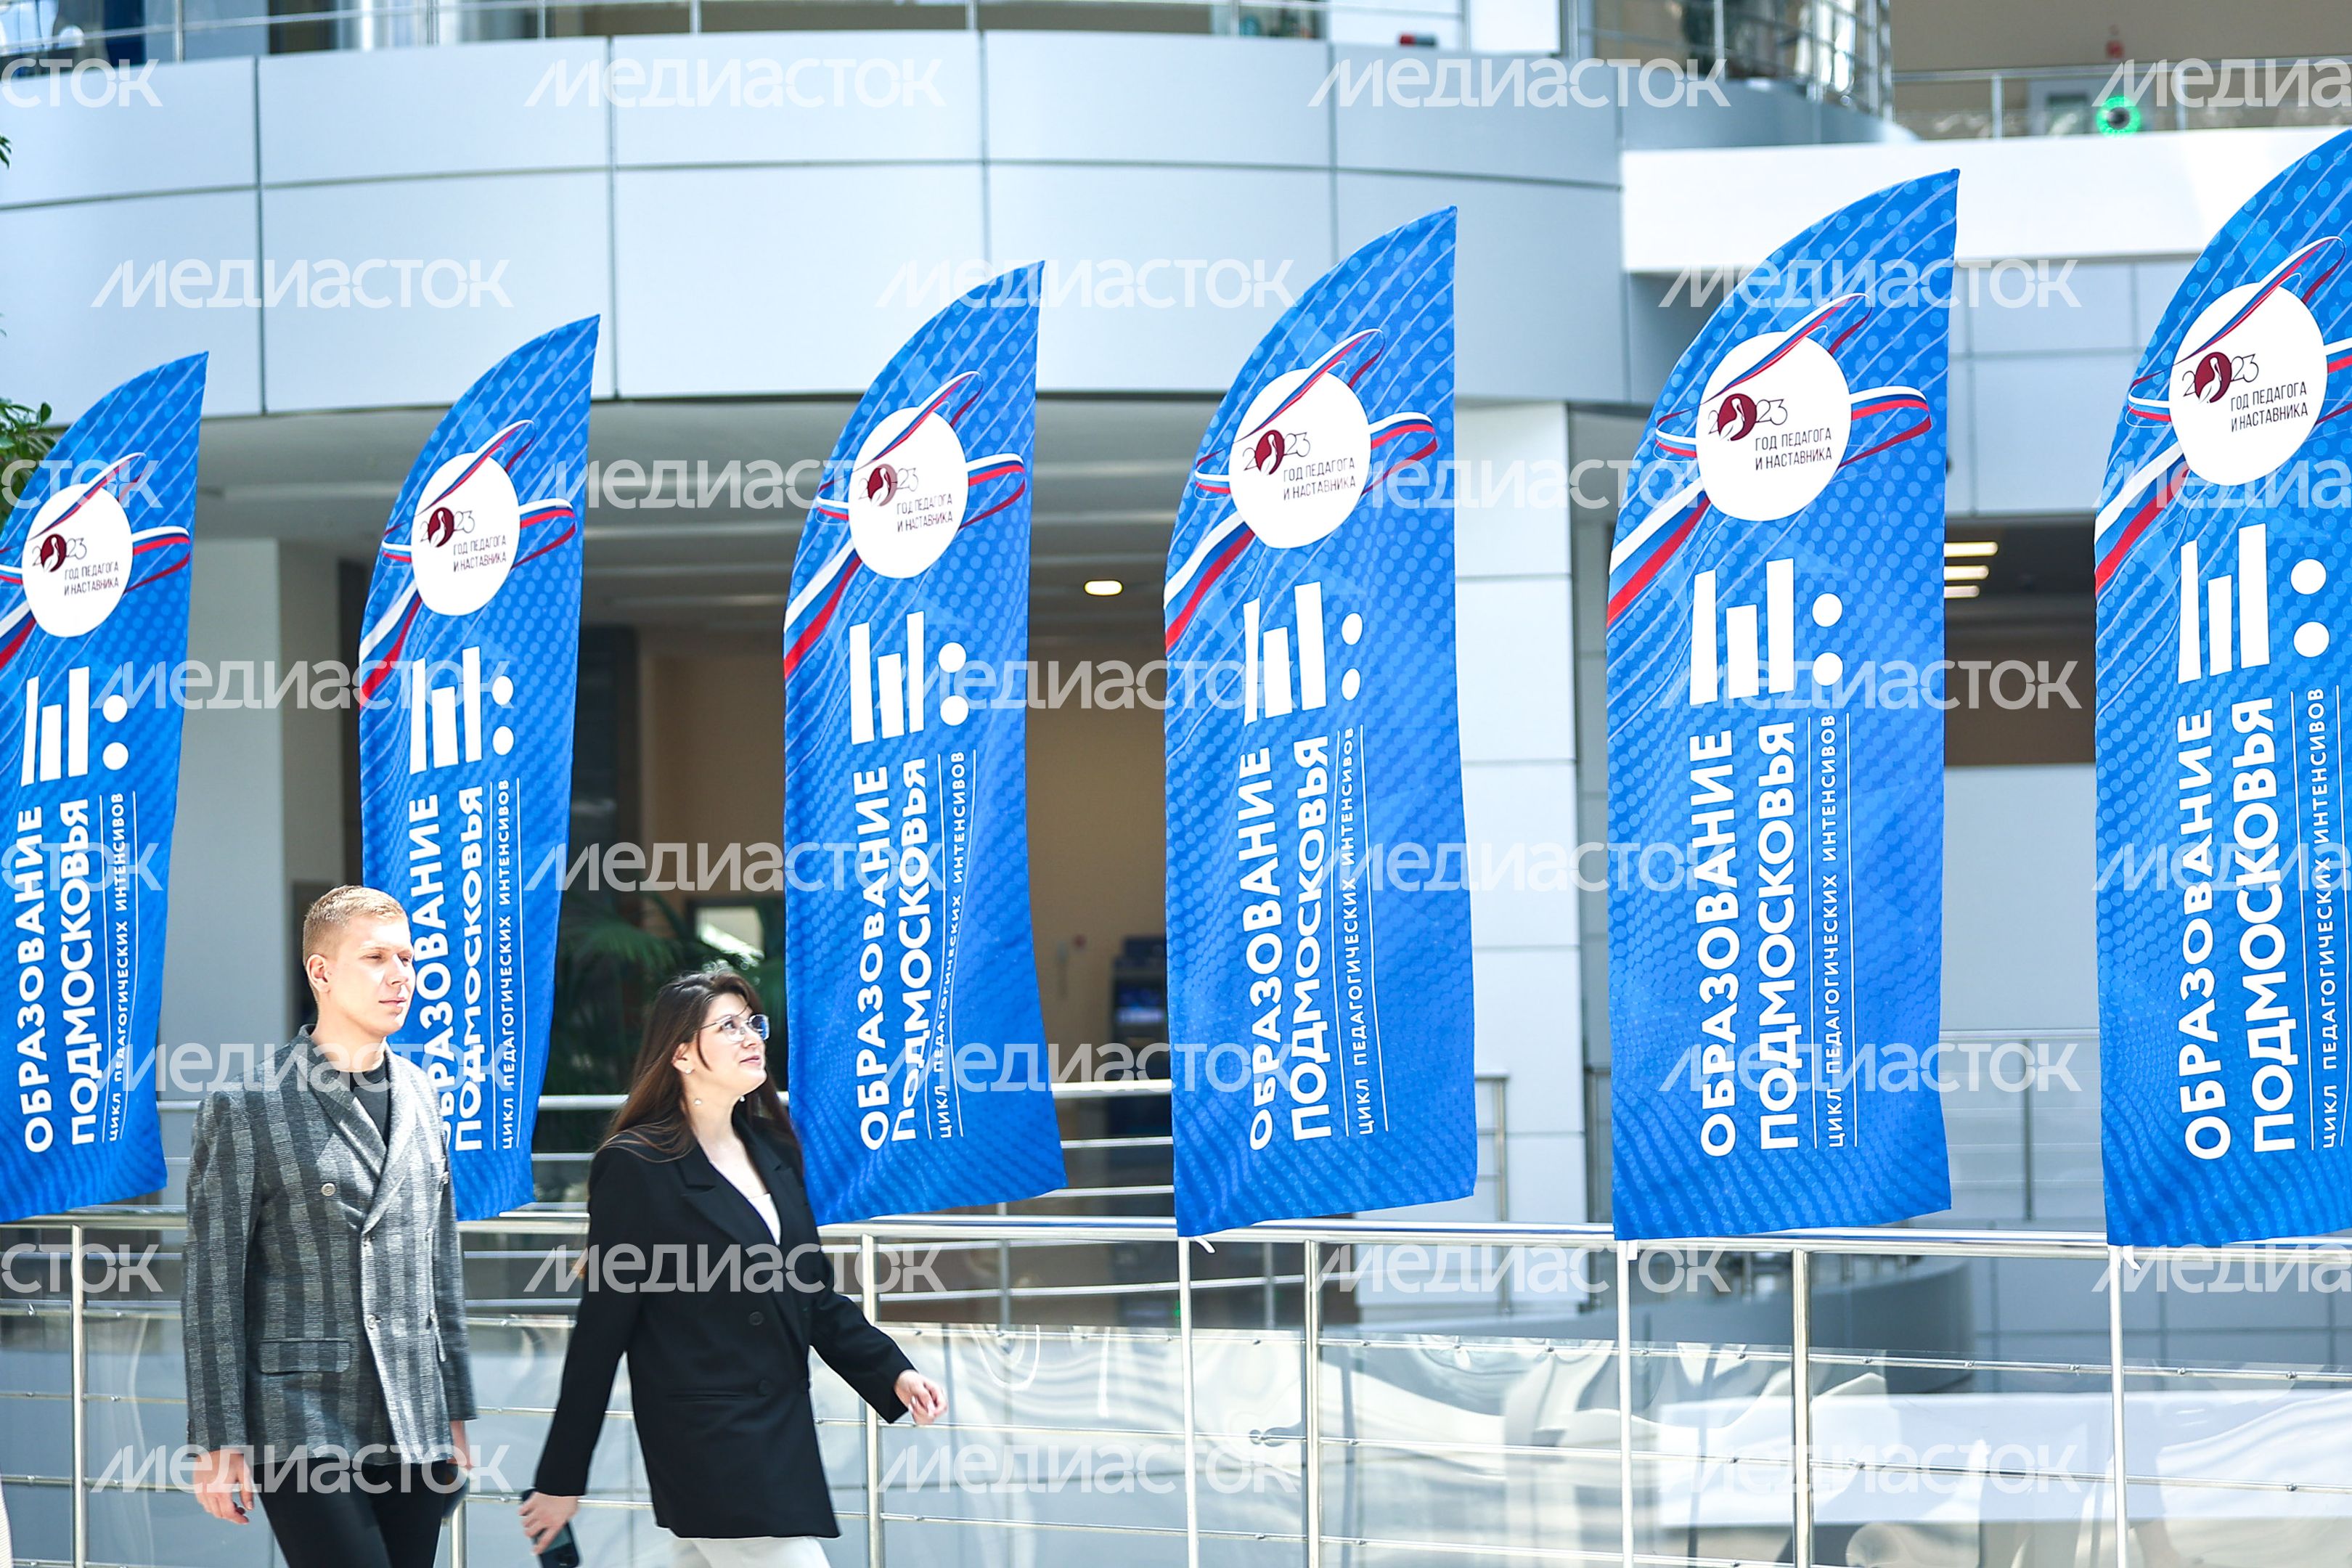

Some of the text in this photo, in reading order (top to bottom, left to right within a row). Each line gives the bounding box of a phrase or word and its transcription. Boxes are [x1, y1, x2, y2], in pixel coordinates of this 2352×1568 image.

[1283, 457, 1355, 483] ГОД ПЕДАГОГА
[1283, 475, 1356, 501] И НАСТАВНИКА
[1755, 428, 1832, 451] ГОД ПЕДАГОГА
[1755, 447, 1832, 470] И НАСТАВНИКА
[2231, 381, 2307, 412] ГОД ПЕДАГОГА
[2231, 402, 2308, 433] И НАСТАВНИКА
[15, 807, 54, 1153] ОБРАЗОВАНИЕ
[60, 799, 102, 1145] ПОДМОСКОВЬЯ
[109, 792, 129, 1141] ЦИКЛ ПЕДАГОГИЧЕСКИХ ИНТЕНСИВОВ
[455, 786, 486, 1151] ПОДМОСКОВЬЯ
[498, 779, 517, 1149] ЦИКЛ ПЕДАГОГИЧЕСКИХ ИНТЕНСИВОВ
[853, 765, 889, 1150] ОБРАЗОВАНИЕ
[891, 759, 932, 1141] ПОДМОСКОВЬЯ
[939, 1085, 952, 1139] ЦИКЛ
[951, 751, 965, 883] ИНТЕНСИВОВ
[1238, 747, 1283, 1151] ОБРАЗОВАНИЕ
[1290, 736, 1333, 1141] ПОДМОСКОВЬЯ
[1339, 727, 1375, 1135] ЦИКЛ ПЕДАГОГИЧЕСКИХ ИНТЕНСИВОВ
[1690, 730, 1740, 1157] ОБРАЗОВАНИЕ
[1758, 722, 1802, 1151] ПОДМОСКОВЬЯ
[1821, 714, 1845, 1148] ЦИКЛ ПЕДАГОГИЧЕСКИХ ИНТЕНСИВОВ
[2177, 709, 2231, 1160] ОБРАЗОВАНИЕ
[2231, 697, 2298, 1153] ПОДМОСКОВЬЯ
[2307, 687, 2338, 1148] ЦИКЛ ПЕДАГОГИЧЕСКИХ ИНТЕНСИВОВ
